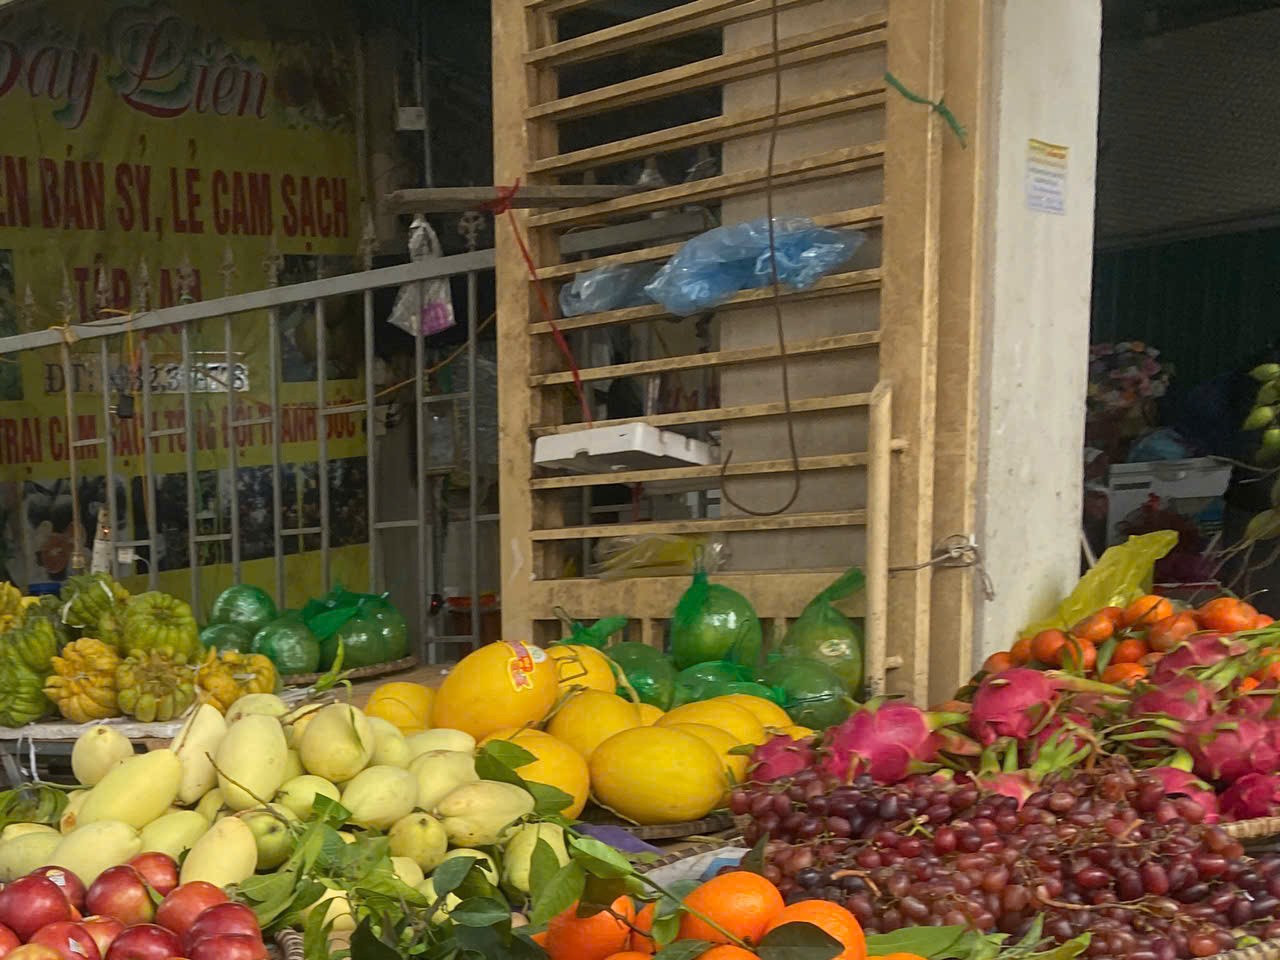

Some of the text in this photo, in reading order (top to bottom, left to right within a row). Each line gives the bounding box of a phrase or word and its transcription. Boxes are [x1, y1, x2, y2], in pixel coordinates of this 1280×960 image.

[39, 144, 107, 231] BÁN
[211, 169, 273, 236] CAM
[280, 173, 350, 252] SẠCH
